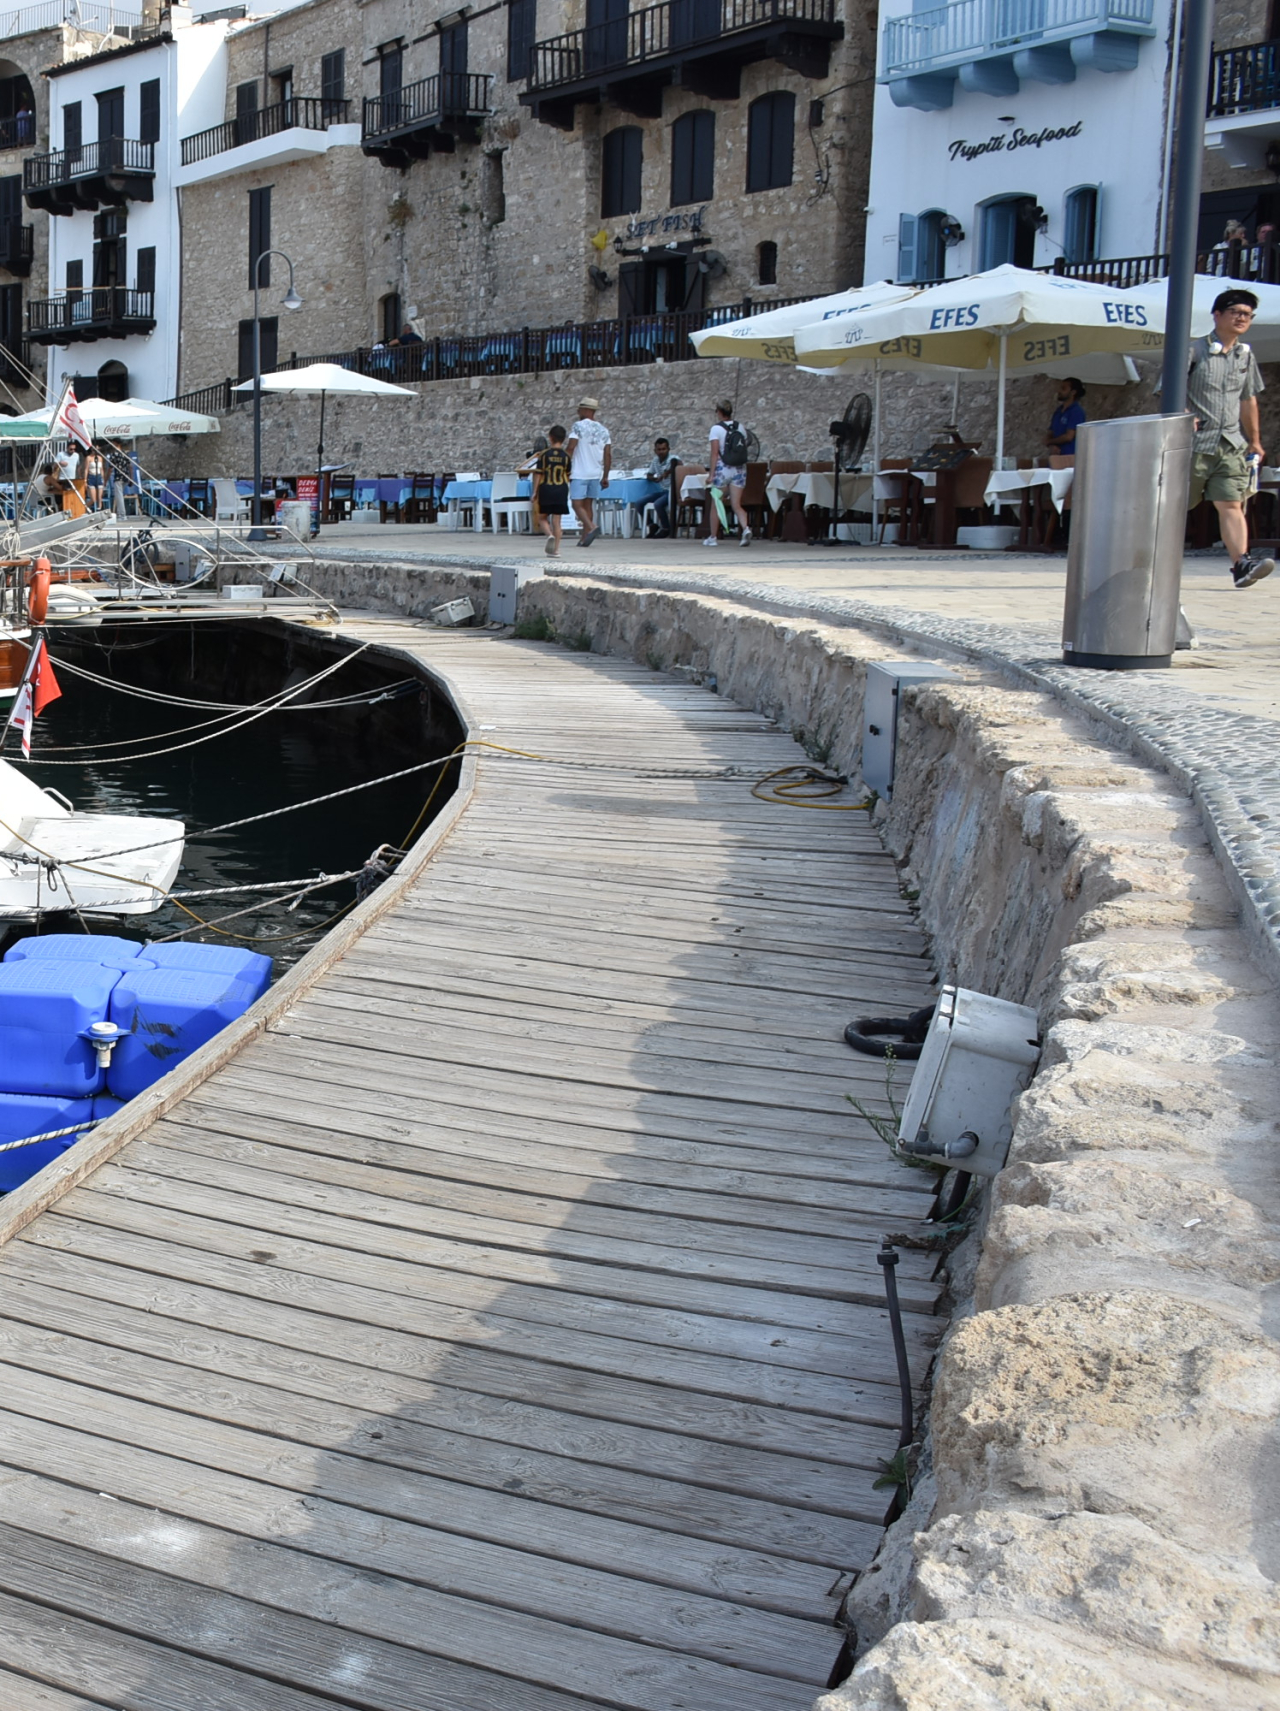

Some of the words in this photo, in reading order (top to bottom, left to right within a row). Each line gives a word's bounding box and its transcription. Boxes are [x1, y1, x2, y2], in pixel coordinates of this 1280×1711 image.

[948, 134, 1006, 161] Trypiti
[1007, 120, 1083, 151] Seafood
[662, 205, 709, 233] FISH
[929, 304, 980, 330] EFES
[1102, 302, 1148, 326] EFES
[546, 464, 564, 485] 10
